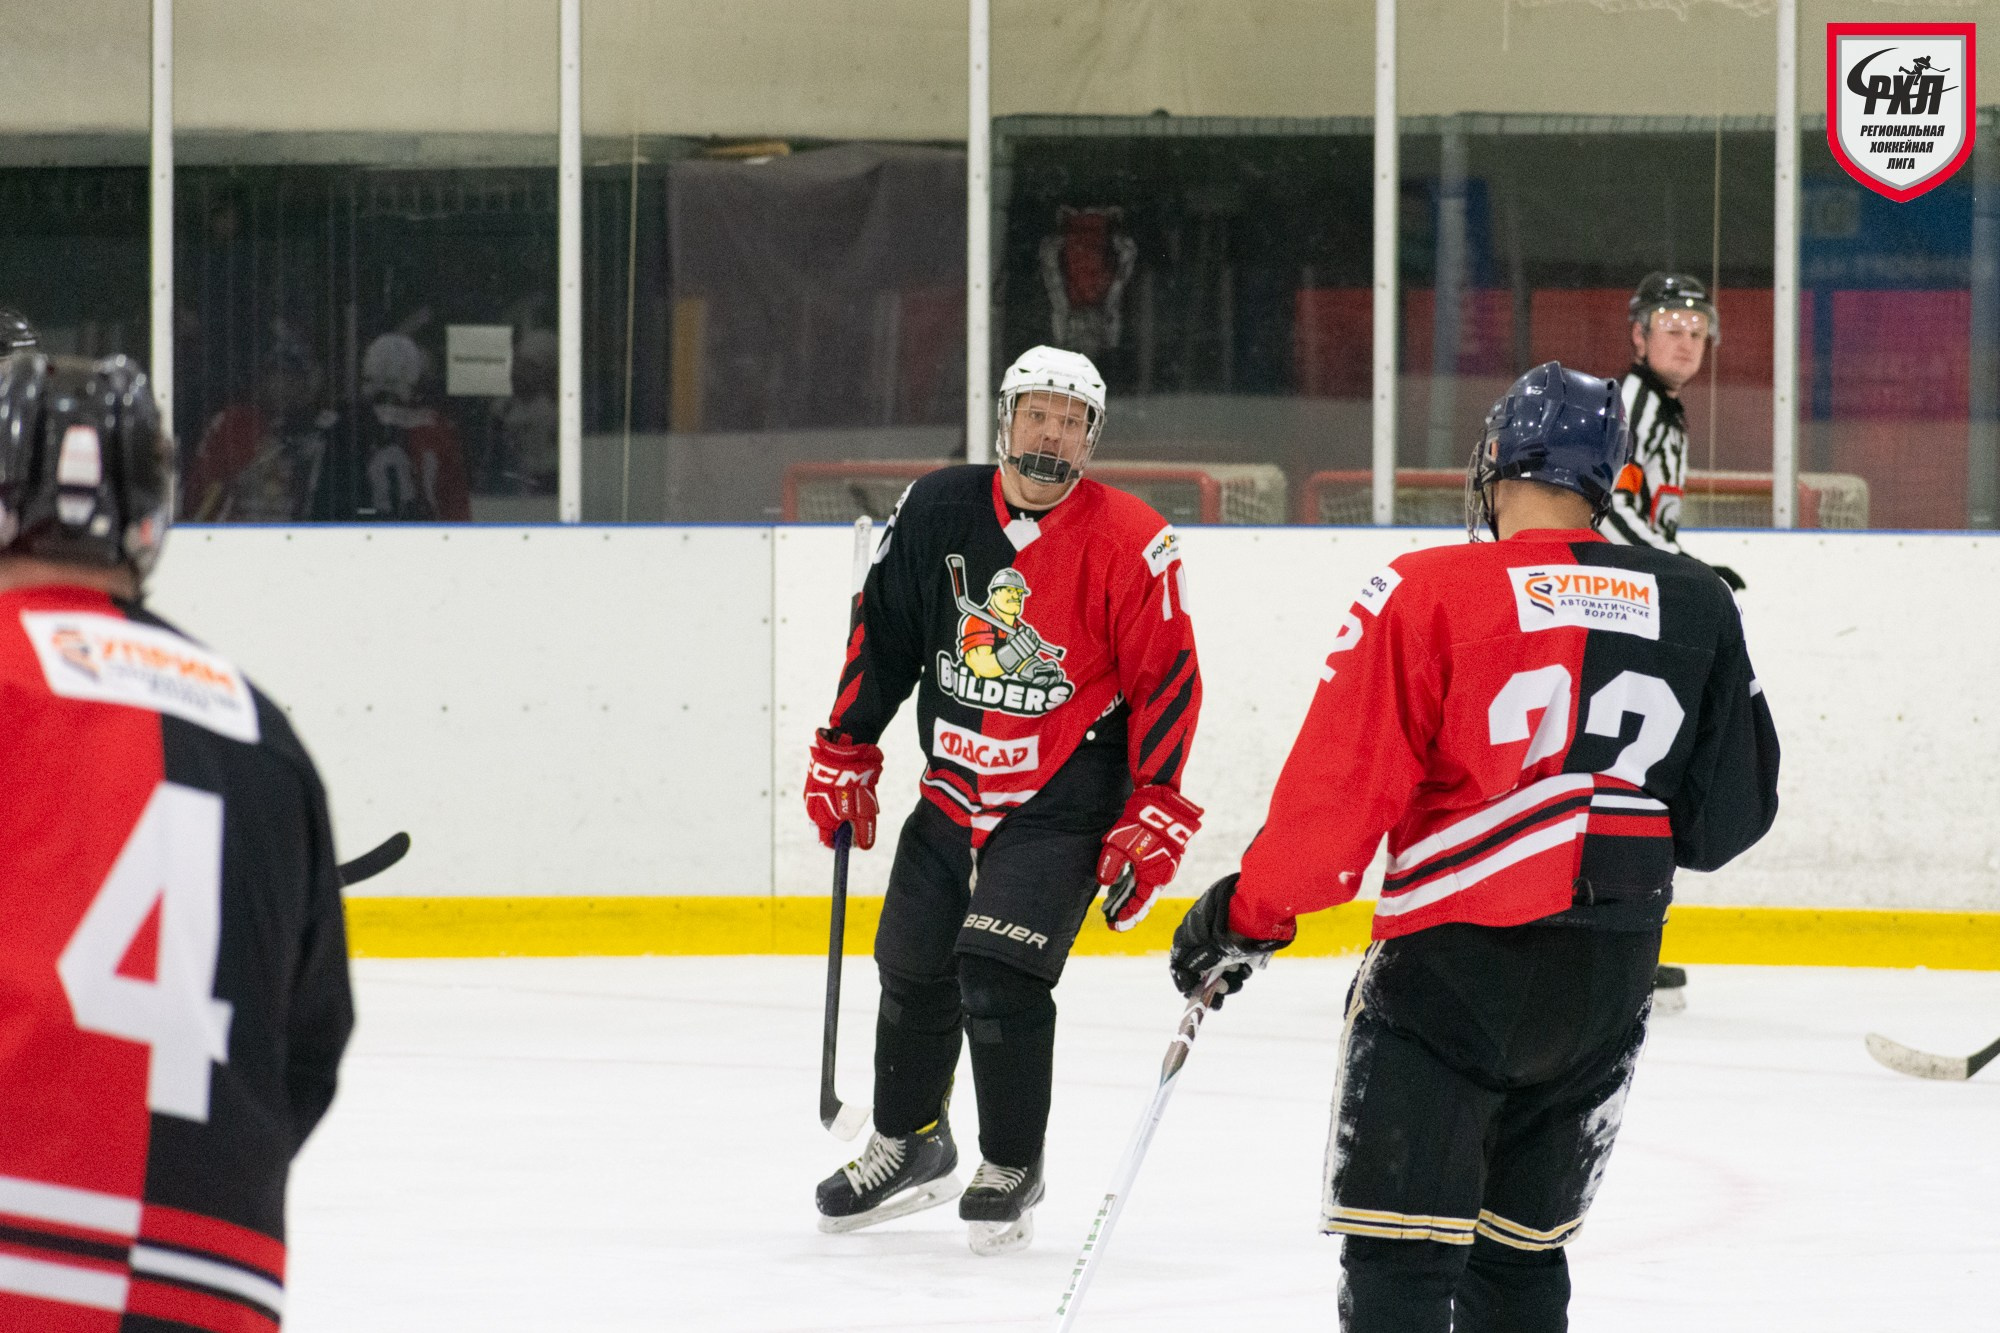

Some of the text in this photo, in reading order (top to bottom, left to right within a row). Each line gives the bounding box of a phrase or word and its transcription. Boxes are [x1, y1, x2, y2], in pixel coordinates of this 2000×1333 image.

[1553, 574, 1649, 604] УПРИМ
[1585, 608, 1628, 621] ВОРОТА
[1488, 664, 1686, 787] 22
[808, 758, 875, 787] CM
[962, 913, 1048, 949] BAUER
[56, 780, 234, 1123] 4
